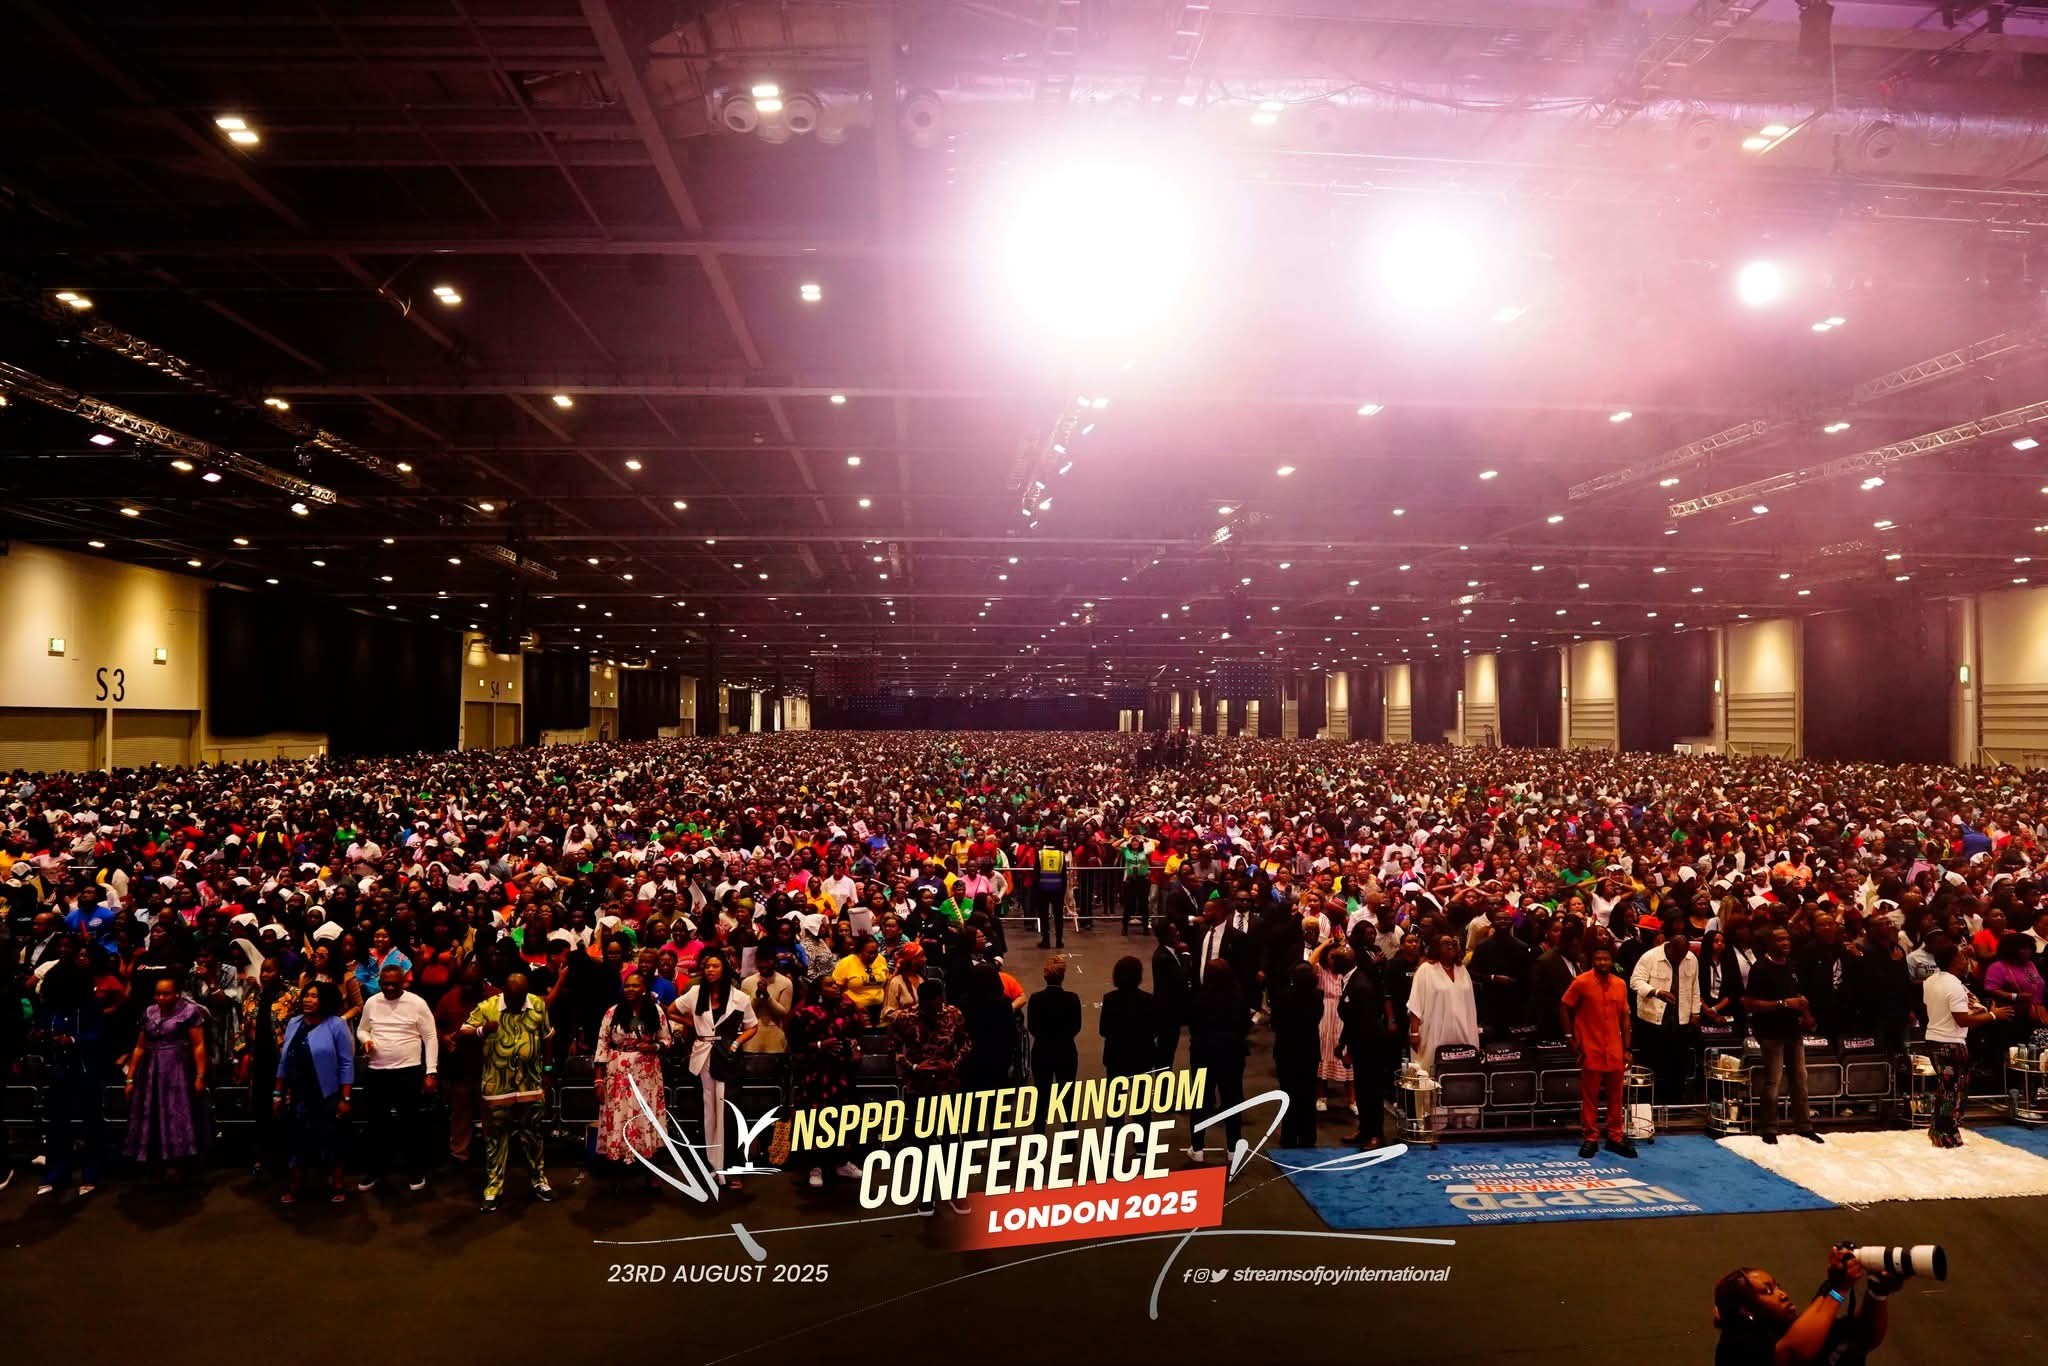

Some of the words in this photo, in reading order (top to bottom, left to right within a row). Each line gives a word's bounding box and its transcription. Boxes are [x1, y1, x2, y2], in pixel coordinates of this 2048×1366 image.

[1451, 1164, 1499, 1172] EXIST
[1542, 1160, 1591, 1168] DOES
[1459, 1171, 1530, 1179] CANNOT
[1578, 1167, 1629, 1175] WHAT
[1426, 1173, 1453, 1181] DO
[1473, 1174, 1600, 1185] CONFERENCE
[1475, 1183, 1577, 1193] PRAYER
[1579, 1180, 1617, 1189] UK
[1449, 1185, 1690, 1211] NSPPD
